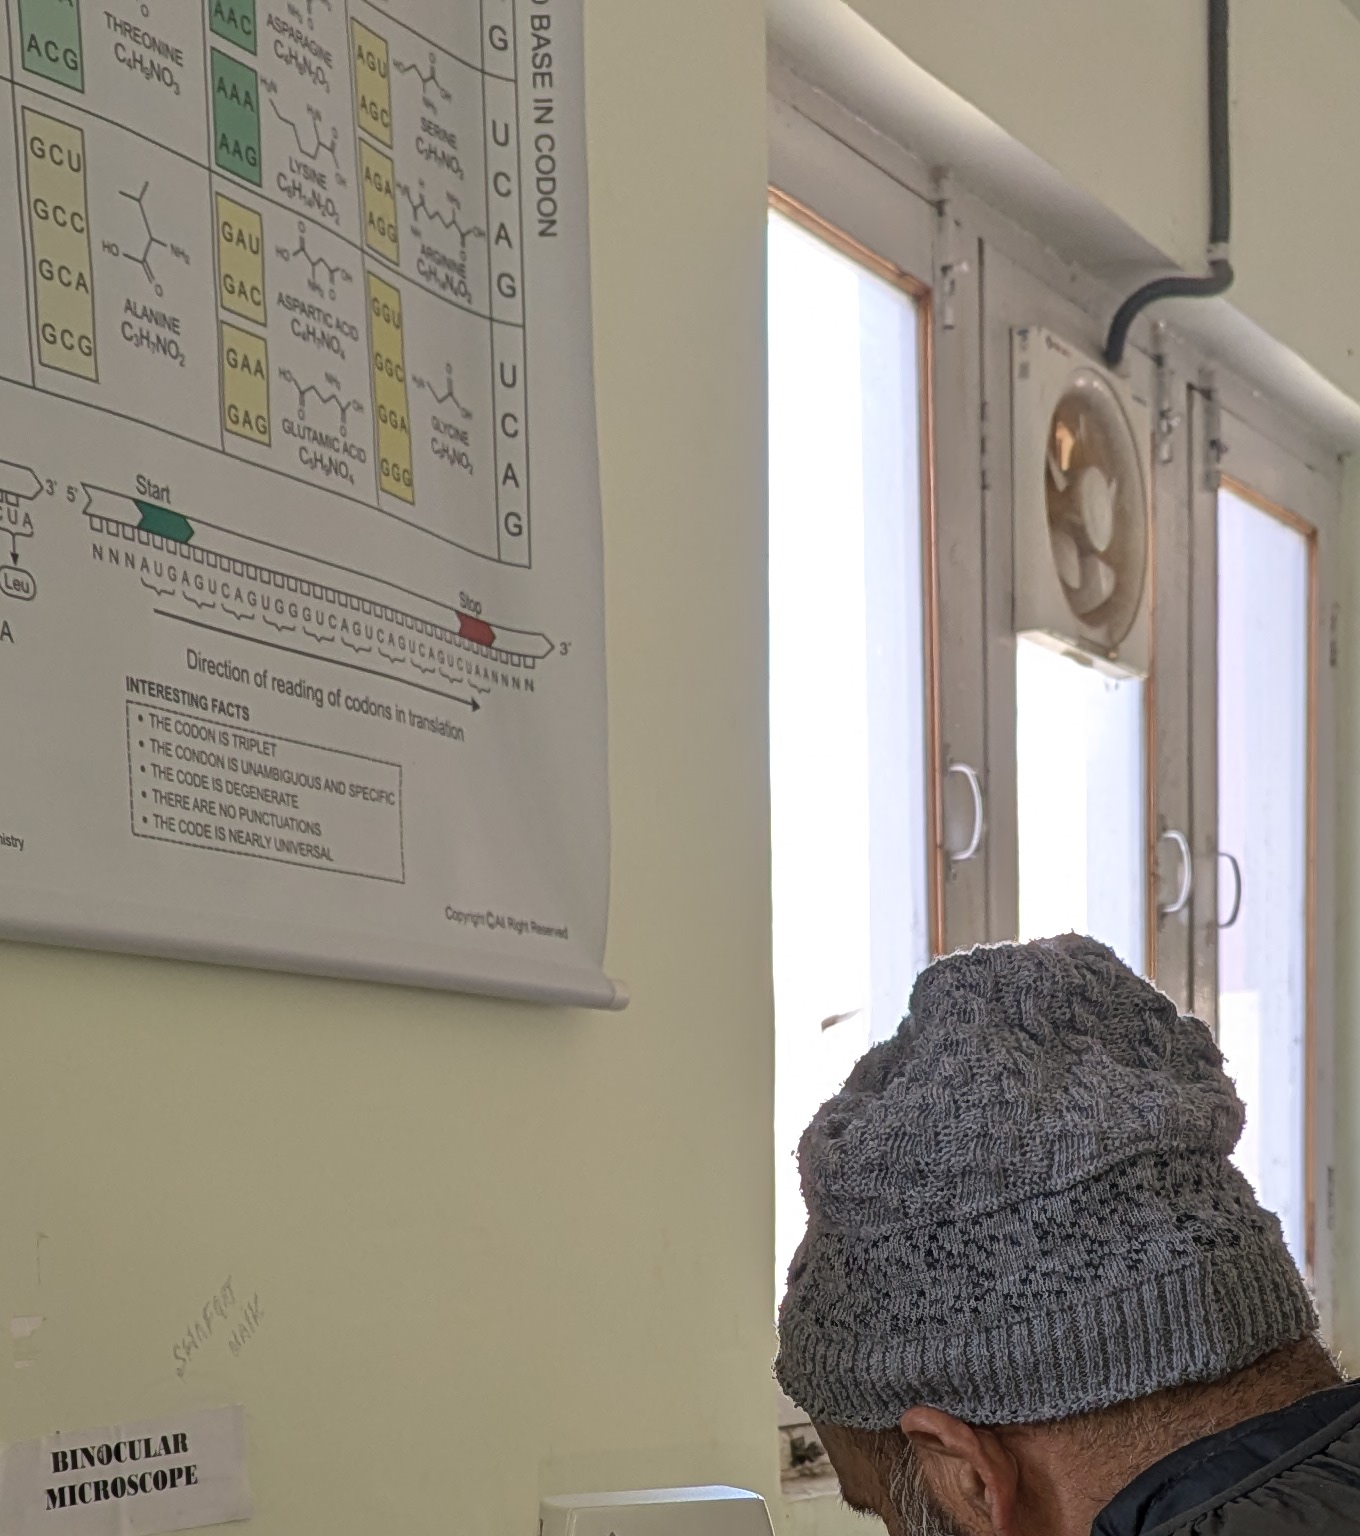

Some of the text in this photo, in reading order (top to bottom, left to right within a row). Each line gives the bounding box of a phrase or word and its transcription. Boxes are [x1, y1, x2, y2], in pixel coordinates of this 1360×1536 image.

[214, 3, 253, 36] AAC
[27, 33, 79, 71] ACG
[103, 10, 185, 68] THREONINE
[488, 24, 508, 51] G
[356, 44, 387, 79] AGU
[216, 76, 256, 112] AAA
[360, 94, 390, 128] AGC
[491, 119, 509, 147] U
[530, 14, 558, 238] BASE IN CODON
[30, 135, 82, 173] GCU
[219, 132, 258, 168] AAG
[364, 166, 392, 197] AGA
[492, 171, 511, 198] C
[33, 197, 86, 235] GCC
[368, 211, 397, 244] AGG
[221, 220, 261, 255] GAU
[494, 222, 512, 249] A
[39, 257, 90, 295] GCA
[223, 273, 262, 308] GAC
[496, 272, 516, 298] G
[124, 298, 181, 336] ALANINE
[277, 291, 333, 329] ASPARTIC
[371, 296, 401, 330] GGU
[41, 322, 94, 358] GCG
[226, 348, 265, 381] GAA
[374, 351, 406, 383] GGC
[499, 361, 517, 388] U
[227, 403, 268, 436] GAG
[282, 417, 341, 453] GLUTAMIC
[378, 403, 409, 435] GGA
[500, 412, 519, 438] C
[135, 474, 172, 505] Start
[380, 458, 413, 488] GGG
[502, 462, 520, 489] A
[504, 511, 523, 537] G
[3, 572, 31, 594] Leu
[458, 590, 483, 617] Stop
[126, 674, 250, 722] INTERESTING FACTS
[187, 648, 465, 743] Direction of reading of codons in translation
[149, 712, 277, 758] THE CODON IS TRIPLET
[150, 737, 397, 806] THE CONDON IS UNAMBIGUOUS AND SPECIFIC
[151, 762, 300, 809] THE CODE IS DEGENERATE
[152, 787, 323, 837] THERE ARE NO PUNCTUATIONS
[153, 812, 334, 863] THE CODE IS NEARLY UNIVERSAL
[51, 1432, 189, 1474] BINOCULAR
[45, 1464, 198, 1511] MICROSCOPE
